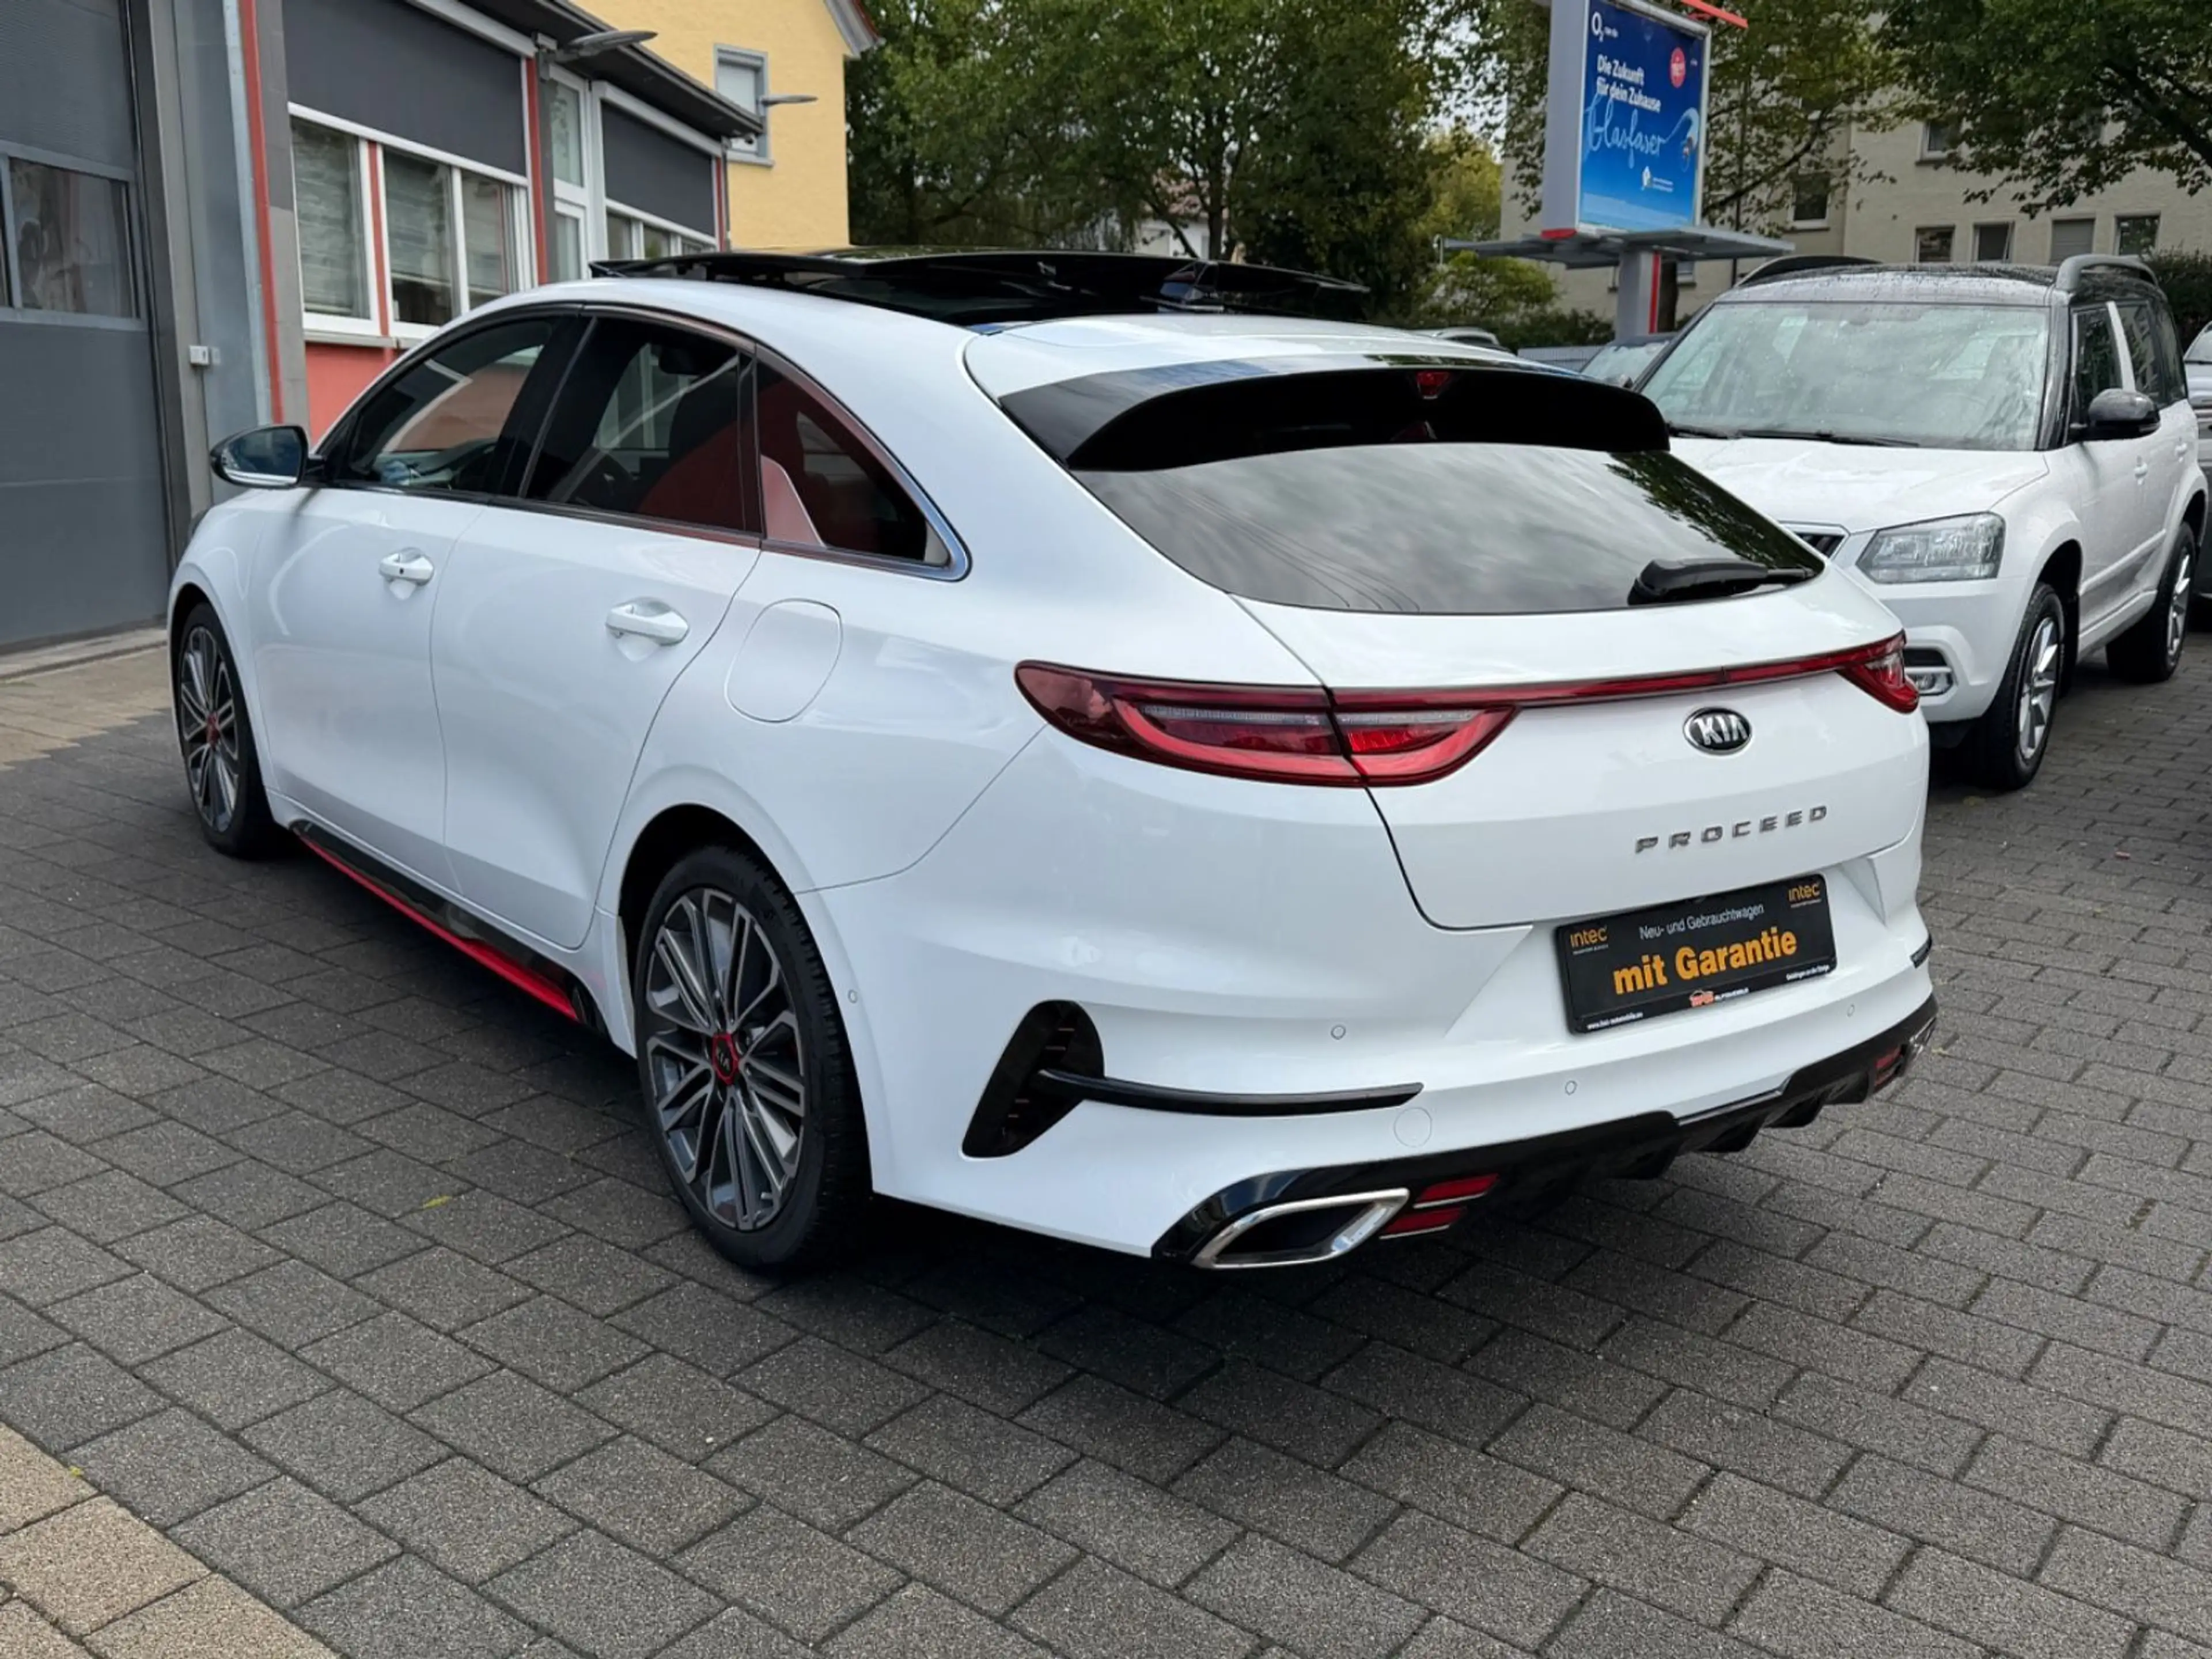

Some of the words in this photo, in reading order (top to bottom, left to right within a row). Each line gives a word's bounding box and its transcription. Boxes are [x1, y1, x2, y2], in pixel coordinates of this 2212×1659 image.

[1597, 54, 1612, 75] Die
[1613, 59, 1644, 85] Zukunft
[1609, 81, 1627, 103] dein
[1628, 86, 1661, 113] Zuhause
[1694, 714, 1747, 745] KIA
[1635, 805, 1827, 854] PROCEED
[1639, 925, 1664, 940] Neu-
[1666, 917, 1685, 934] und
[1686, 903, 1764, 930] Gebrauchtwagen
[1614, 954, 1668, 994] mit
[1675, 926, 1797, 980] Garantie
